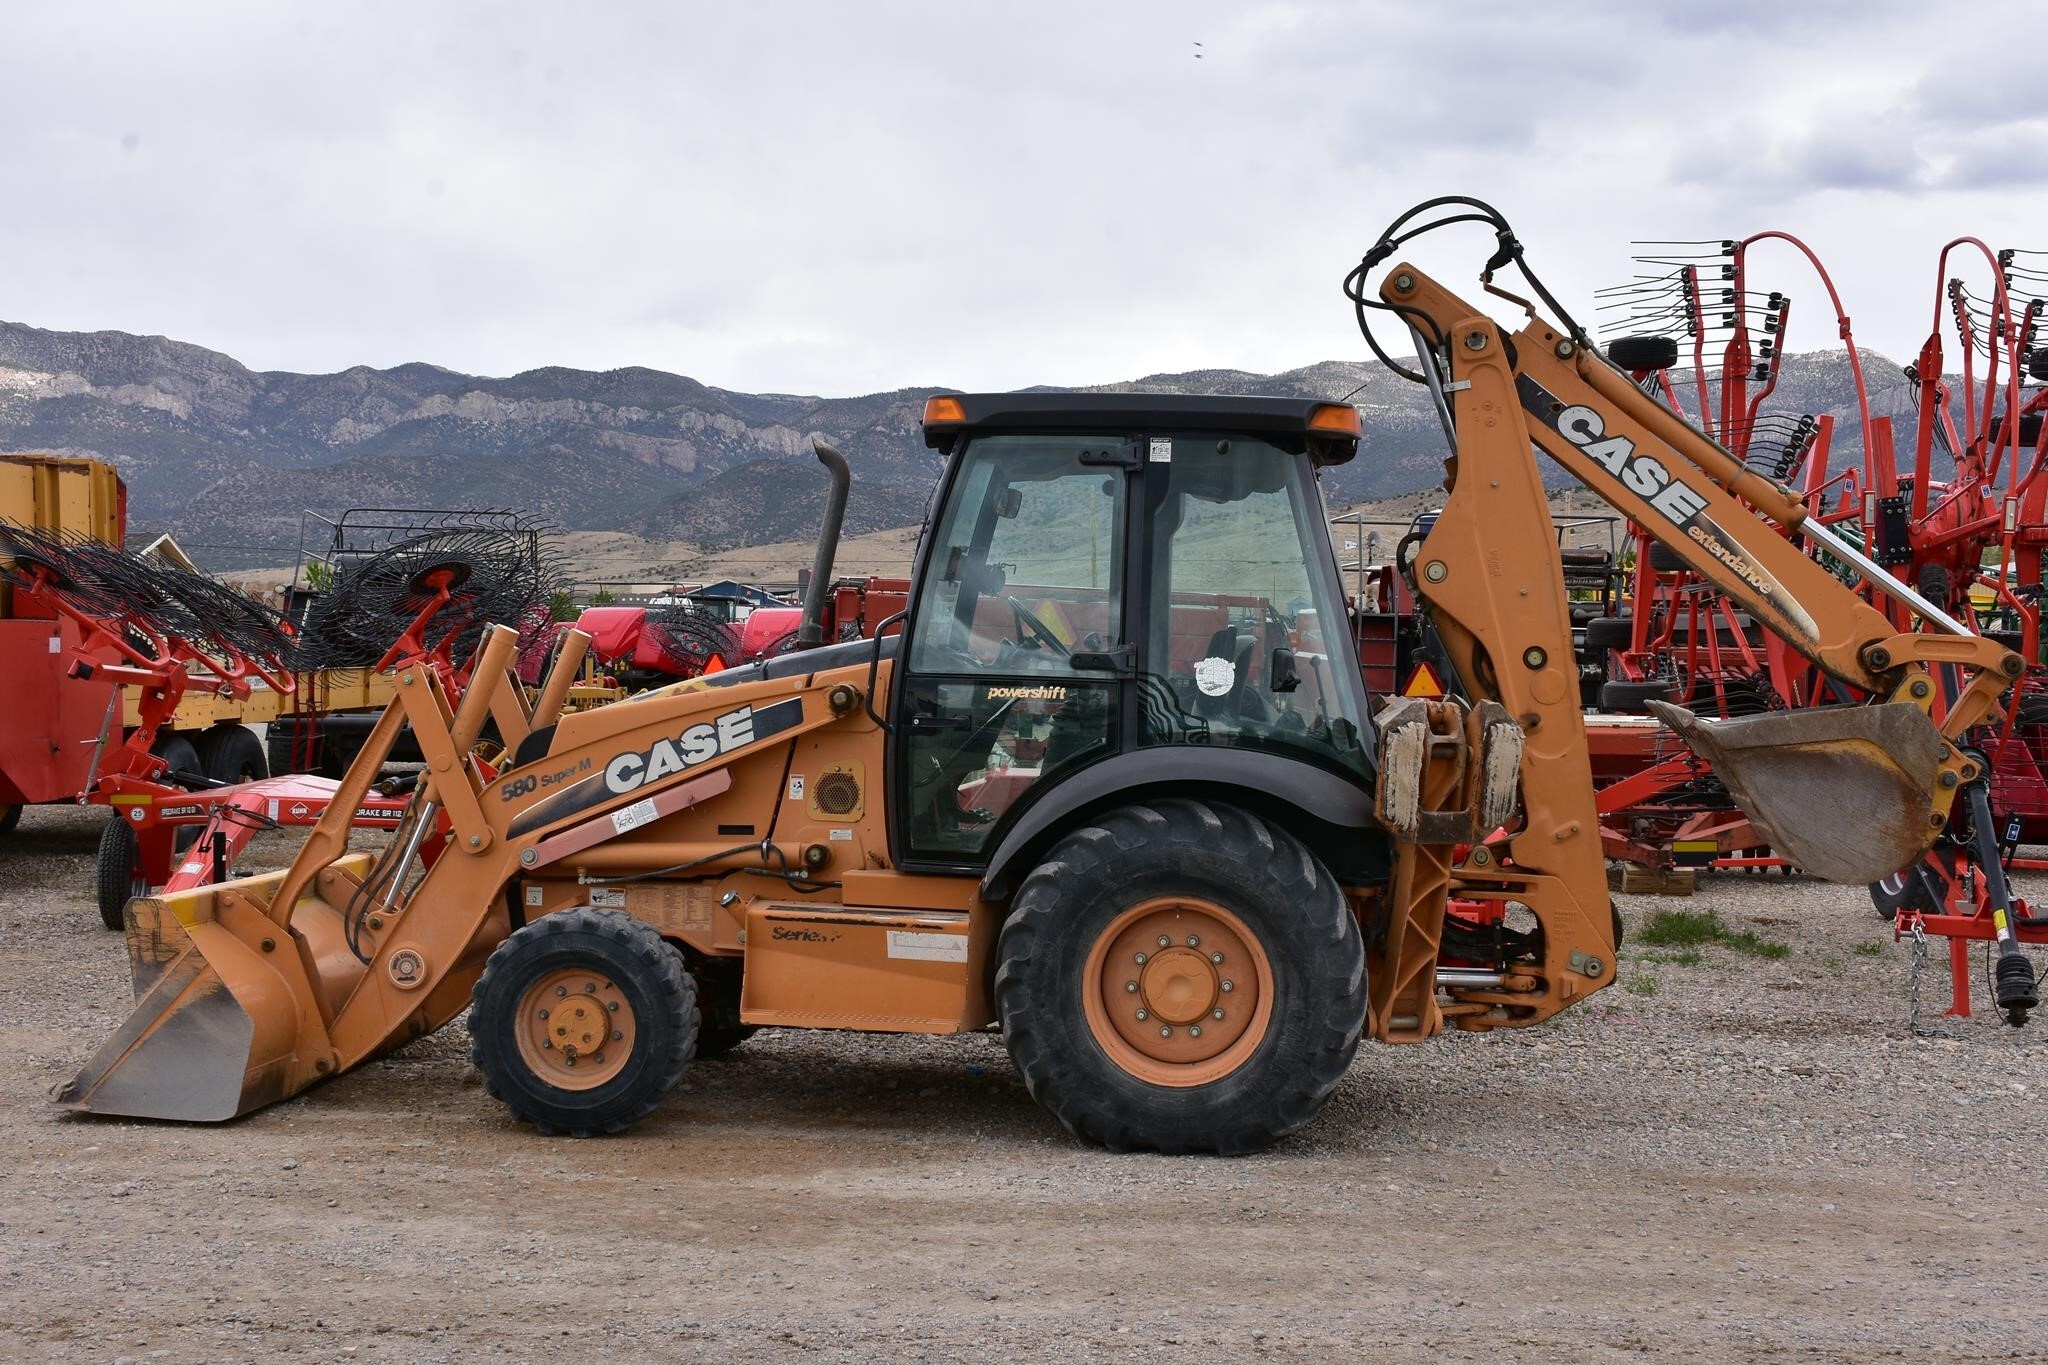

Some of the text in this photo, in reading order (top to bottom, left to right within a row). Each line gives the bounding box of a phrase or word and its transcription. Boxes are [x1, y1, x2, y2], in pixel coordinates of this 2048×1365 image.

[1557, 405, 1711, 526] CASE
[1687, 525, 1772, 594] extendahoe
[987, 686, 1066, 700] powershift
[501, 757, 591, 802] 580 Super M
[604, 705, 755, 794] CASE
